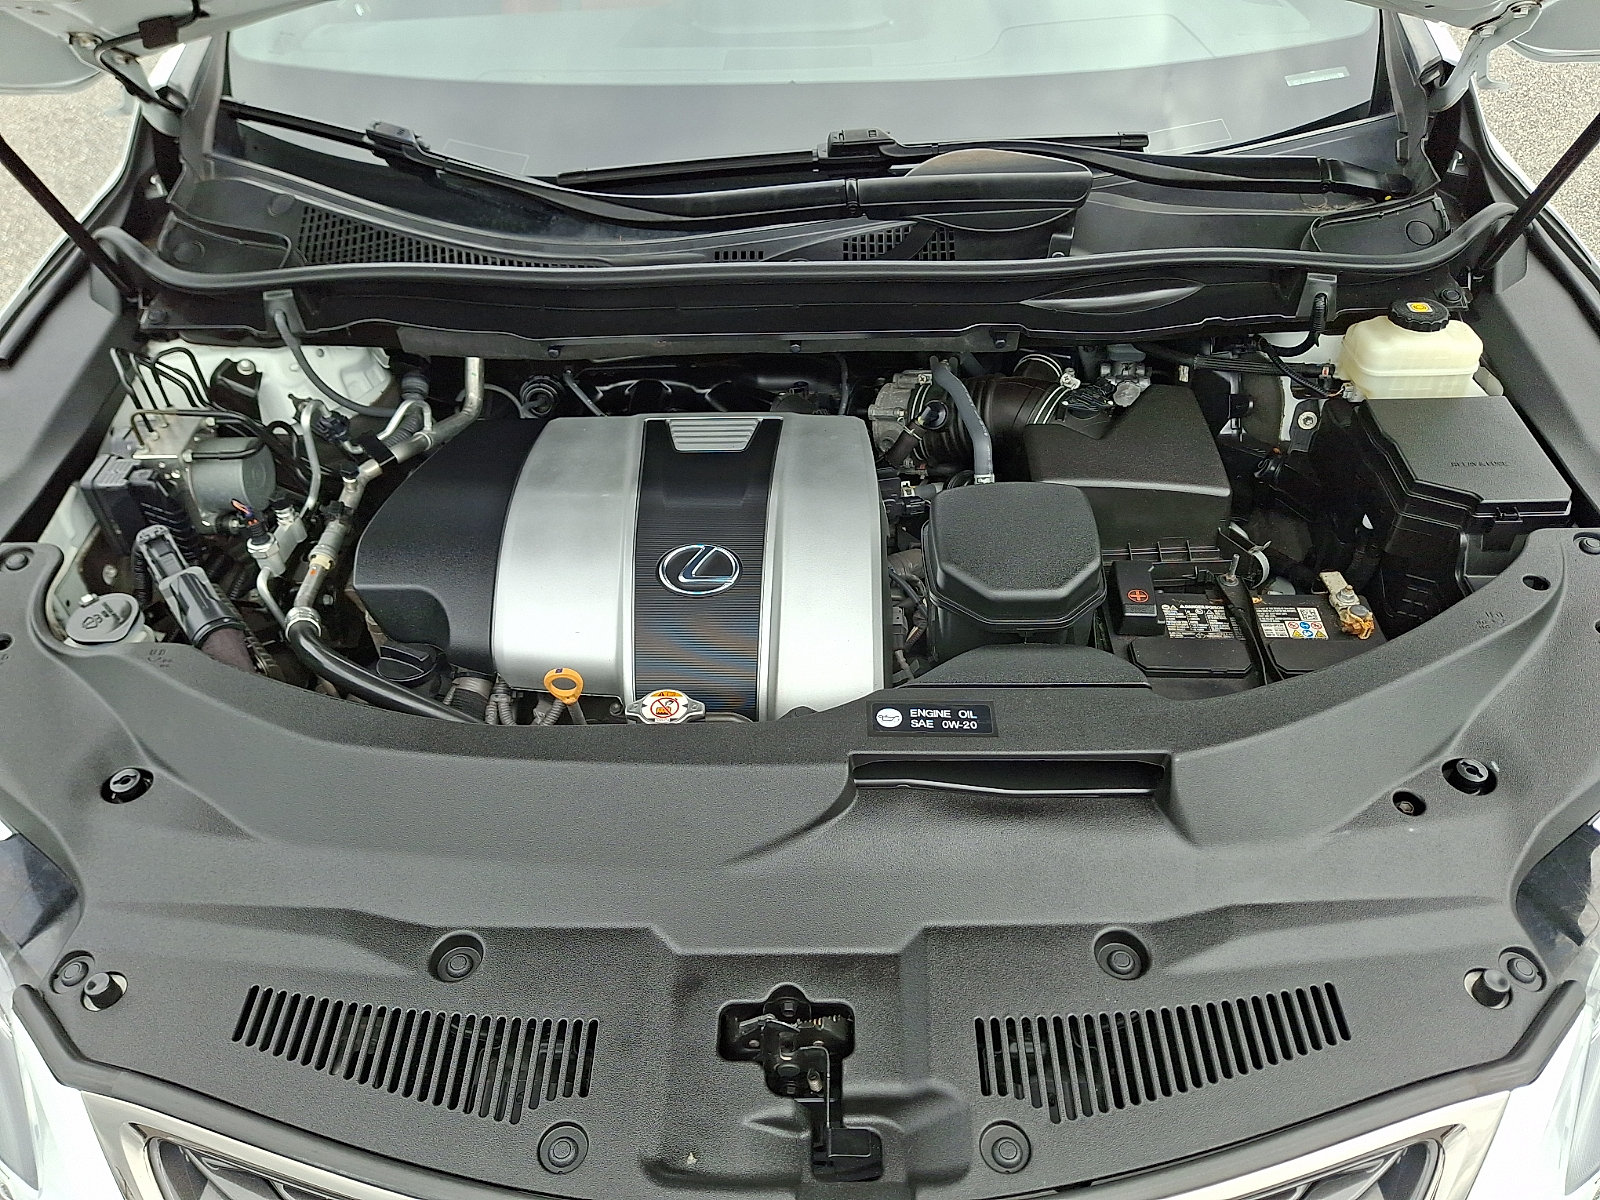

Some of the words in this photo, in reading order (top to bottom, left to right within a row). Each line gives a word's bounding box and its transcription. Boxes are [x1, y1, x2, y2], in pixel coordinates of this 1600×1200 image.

[910, 708, 952, 718] ENGINE
[958, 709, 978, 719] OIL
[910, 719, 934, 729] SAE
[941, 720, 978, 730] 0W-20
